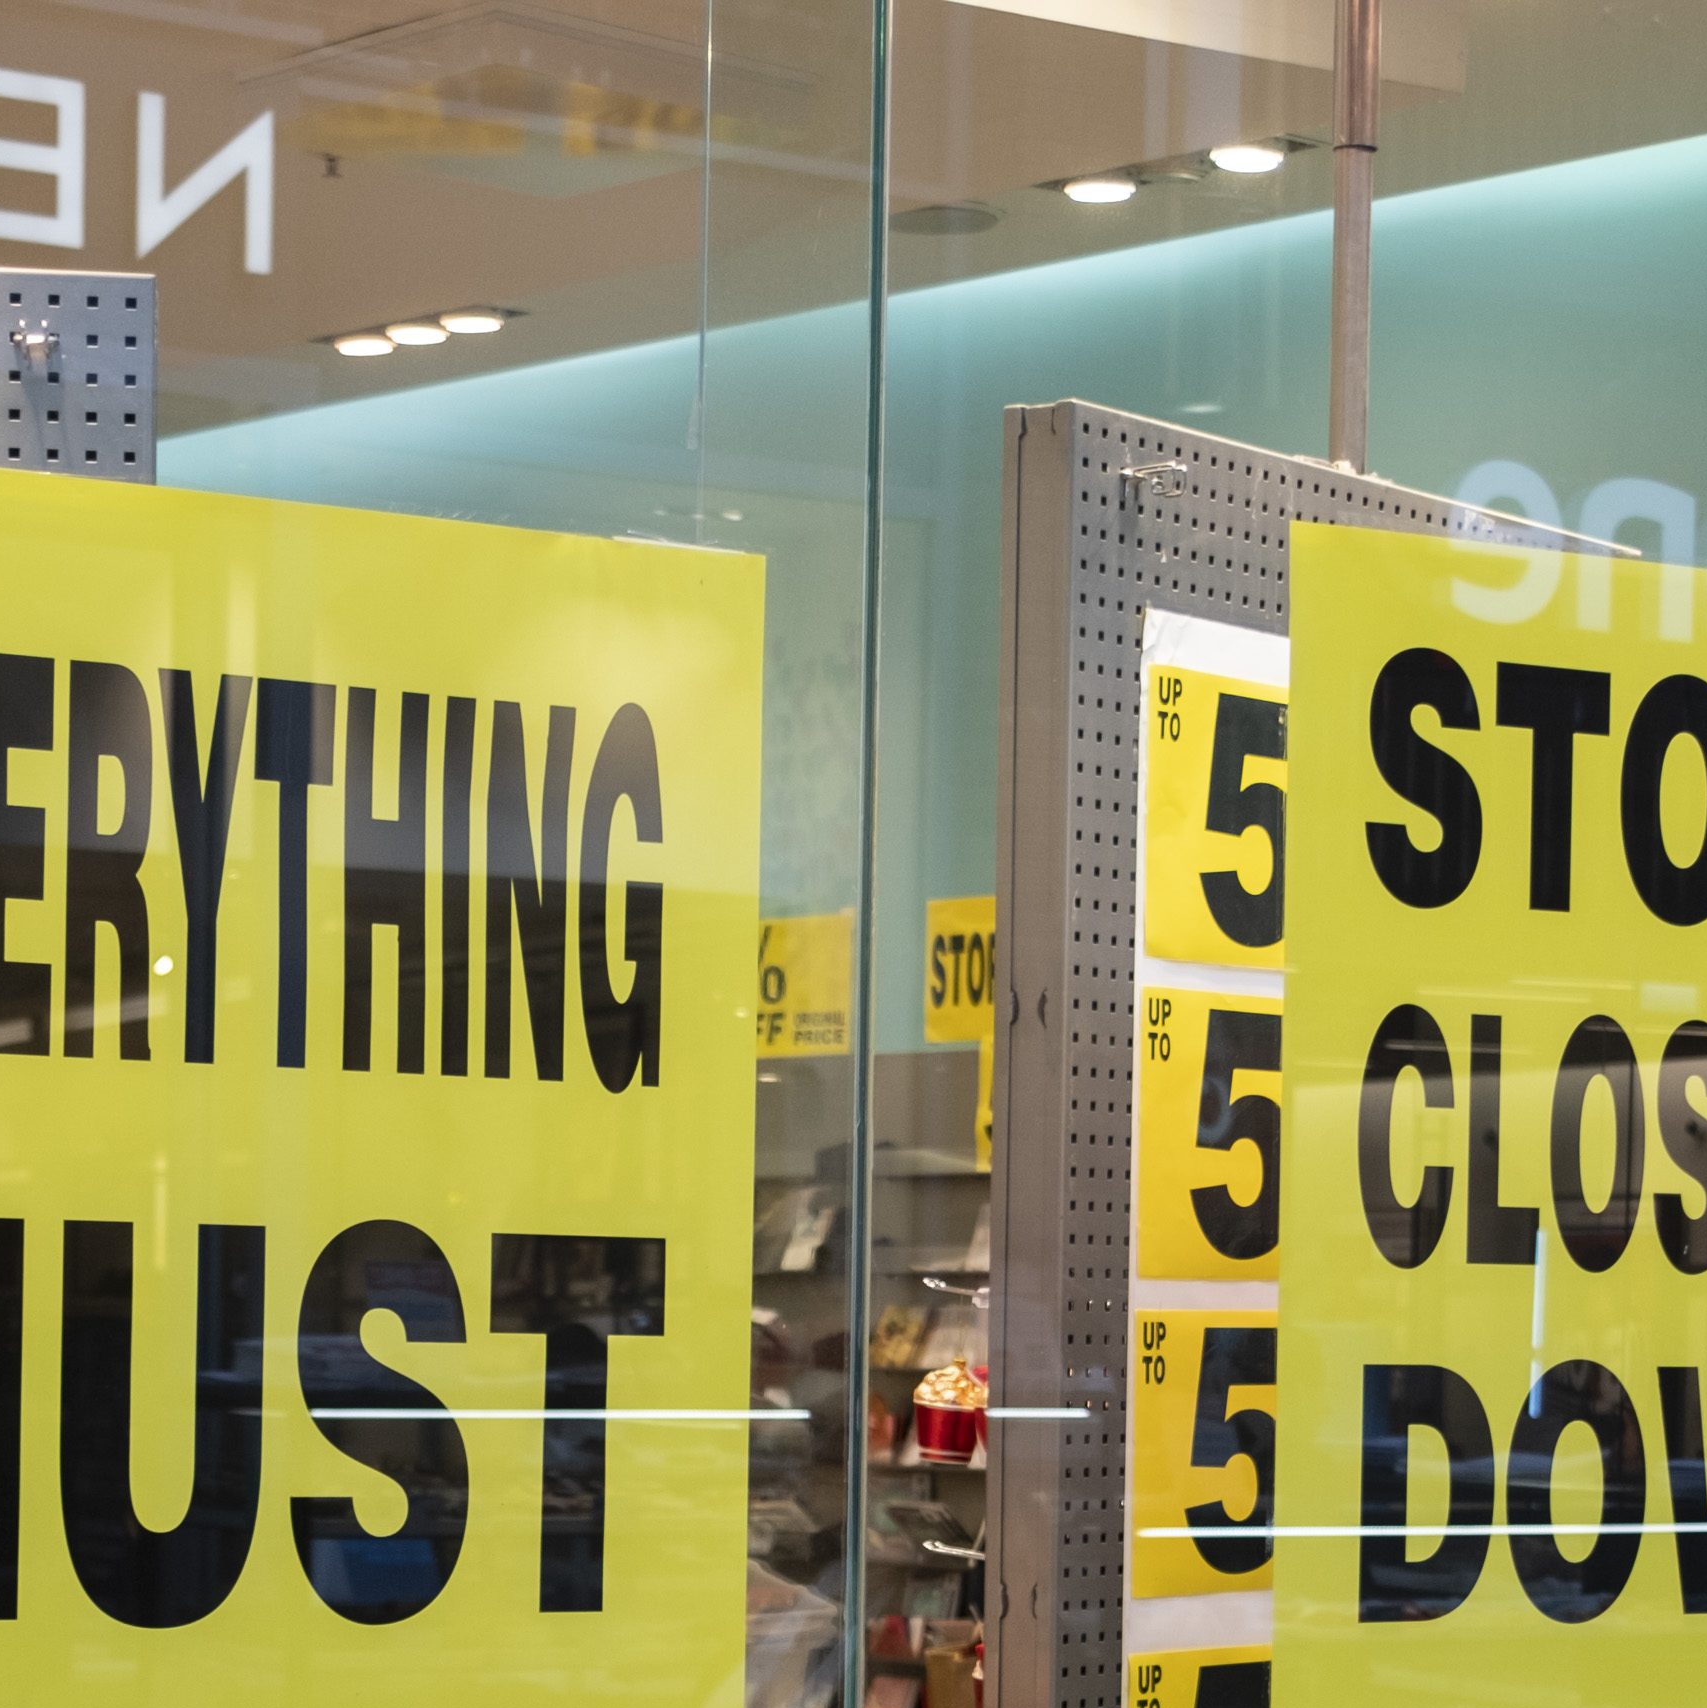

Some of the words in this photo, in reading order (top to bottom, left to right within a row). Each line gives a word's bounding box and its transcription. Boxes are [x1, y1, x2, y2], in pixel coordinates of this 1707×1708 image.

[1159, 676, 1183, 705] UP
[1158, 711, 1179, 740] TO
[1149, 999, 1172, 1026] UP
[1147, 1032, 1170, 1062] TO
[1143, 1322, 1167, 1350] UP
[1142, 1355, 1166, 1384] TO
[1138, 1665, 1162, 1694] UP
